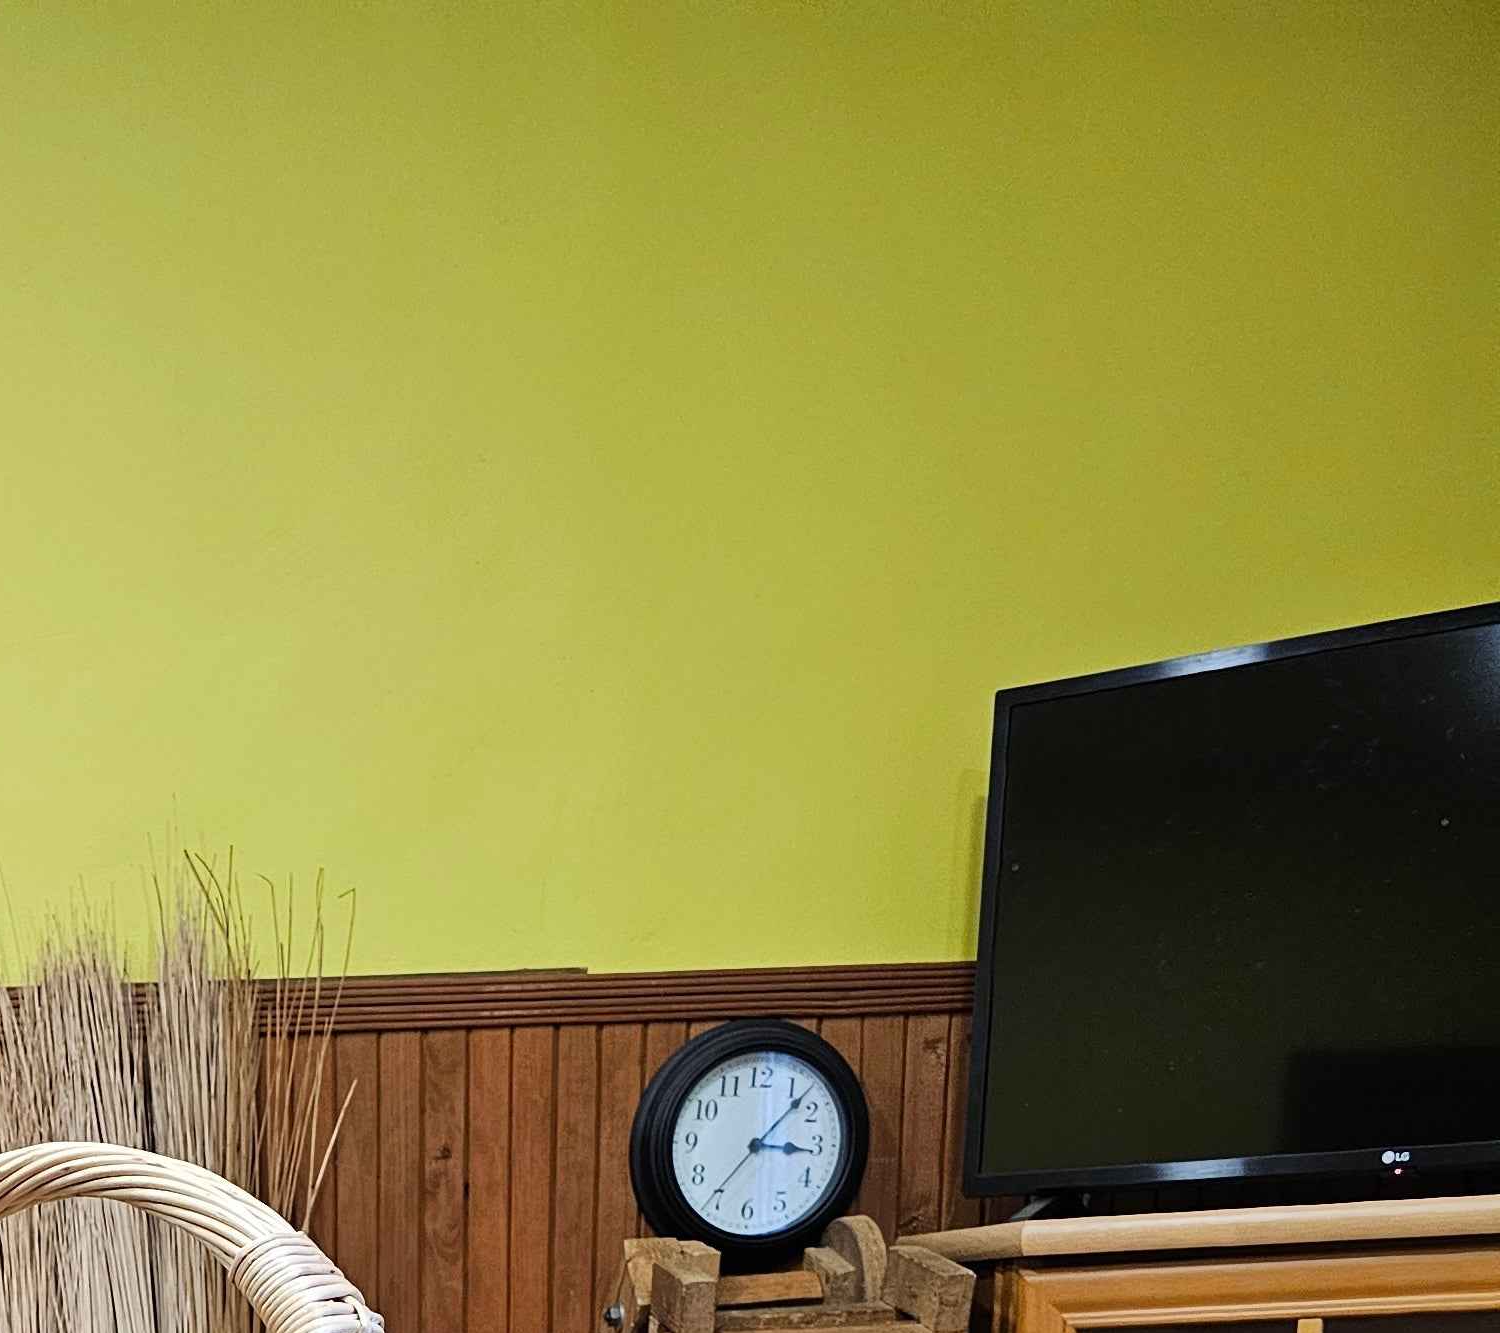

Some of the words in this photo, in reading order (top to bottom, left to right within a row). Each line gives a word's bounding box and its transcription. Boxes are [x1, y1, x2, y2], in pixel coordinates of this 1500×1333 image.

[719, 1076, 740, 1097] 11
[749, 1066, 773, 1088] 12
[788, 1077, 796, 1098] 1
[694, 1099, 718, 1121] 10
[804, 1102, 818, 1123] 2
[685, 1131, 698, 1154] 9
[811, 1135, 823, 1156] 3
[1395, 1152, 1410, 1162] LG
[692, 1164, 705, 1185] 8
[798, 1166, 812, 1188] 4
[714, 1188, 724, 1210] 7
[773, 1191, 787, 1212] 5
[741, 1201, 754, 1220] 6
